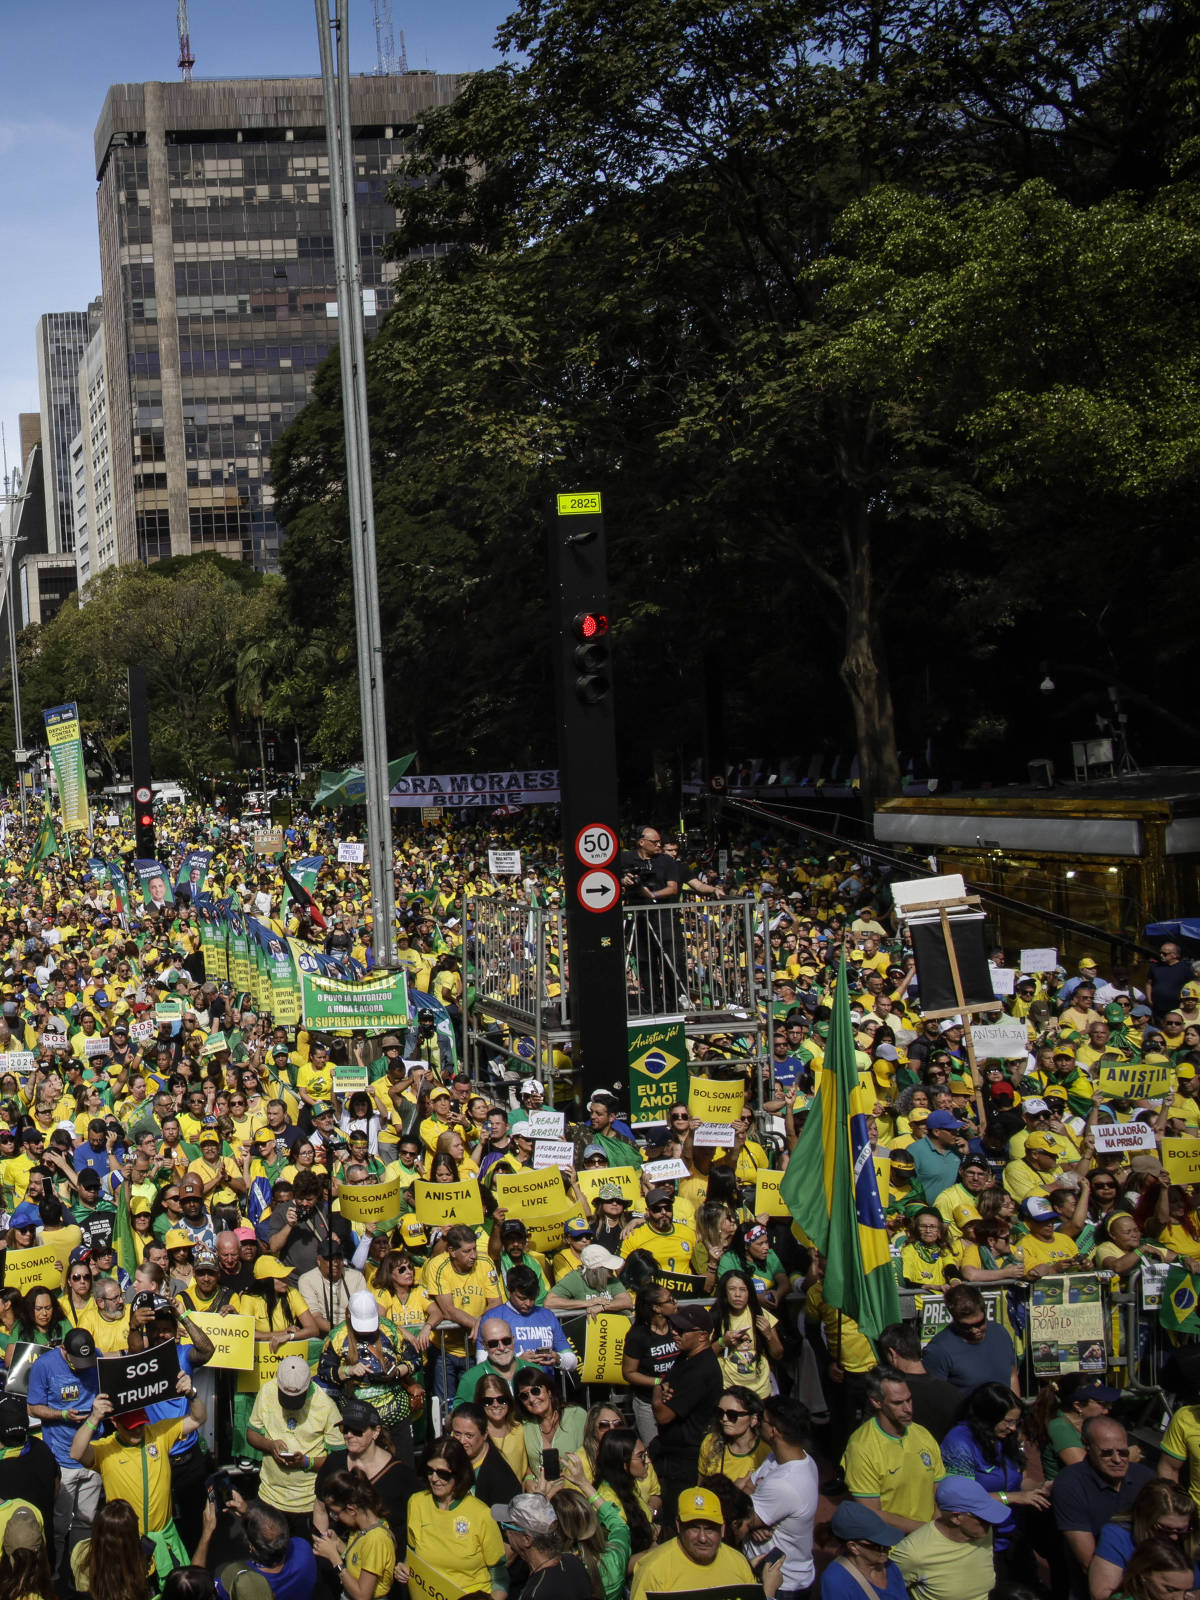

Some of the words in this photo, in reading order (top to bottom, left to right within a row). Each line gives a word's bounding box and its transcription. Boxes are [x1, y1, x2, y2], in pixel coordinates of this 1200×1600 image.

[570, 498, 597, 509] 2825
[396, 776, 442, 794] ORA
[433, 793, 522, 807] BUZINE
[584, 833, 610, 853] 50
[323, 993, 343, 1003] POVO
[352, 991, 393, 1002] AUTORIZOU
[333, 1005, 354, 1013] HORA
[359, 1004, 384, 1013] AGORA
[131, 1022, 153, 1033] SOS
[306, 1017, 313, 1028] O
[315, 1016, 362, 1027] SUPREMO
[372, 1016, 378, 1026] O
[380, 1014, 407, 1025] POVO
[44, 1034, 66, 1043] SOS
[133, 1028, 153, 1038] TRUMP
[973, 1027, 1008, 1040] ANISTIA
[629, 1031, 665, 1051] Anistia
[1106, 1068, 1168, 1081] ANISTIA
[637, 1084, 657, 1097] EU
[660, 1081, 678, 1094] TE
[693, 1088, 744, 1101] BOLSONARO
[1124, 1082, 1151, 1098] JÁ!
[640, 1094, 677, 1108] AMO!
[708, 1104, 733, 1113] LIVRE
[1098, 1126, 1117, 1137] LULA
[1118, 1124, 1148, 1135] LADRÃO
[1105, 1138, 1116, 1148] NA
[1116, 1136, 1143, 1148] PRISÃO
[502, 1176, 560, 1195] BOLSONARO
[342, 1187, 399, 1203] BOLSONARO
[425, 1189, 472, 1201] ANISTIA
[521, 1196, 549, 1207] LIVRE
[359, 1205, 385, 1215] LIVRE
[441, 1206, 457, 1219] JÁ
[3, 1255, 56, 1272] BOLSONARO
[667, 1257, 675, 1273] 9
[19, 1273, 43, 1285] LIVRE
[652, 1277, 694, 1293] NISTIA
[1031, 1305, 1057, 1318] SOS
[1031, 1317, 1072, 1330] DONALD
[515, 1326, 553, 1341] ESTAMOS
[595, 1318, 608, 1380] BOLSONARO
[614, 1338, 623, 1366] LIVRE
[126, 1359, 159, 1379] SOS
[61, 1384, 79, 1394] FORA
[117, 1380, 169, 1405] TRUMP
